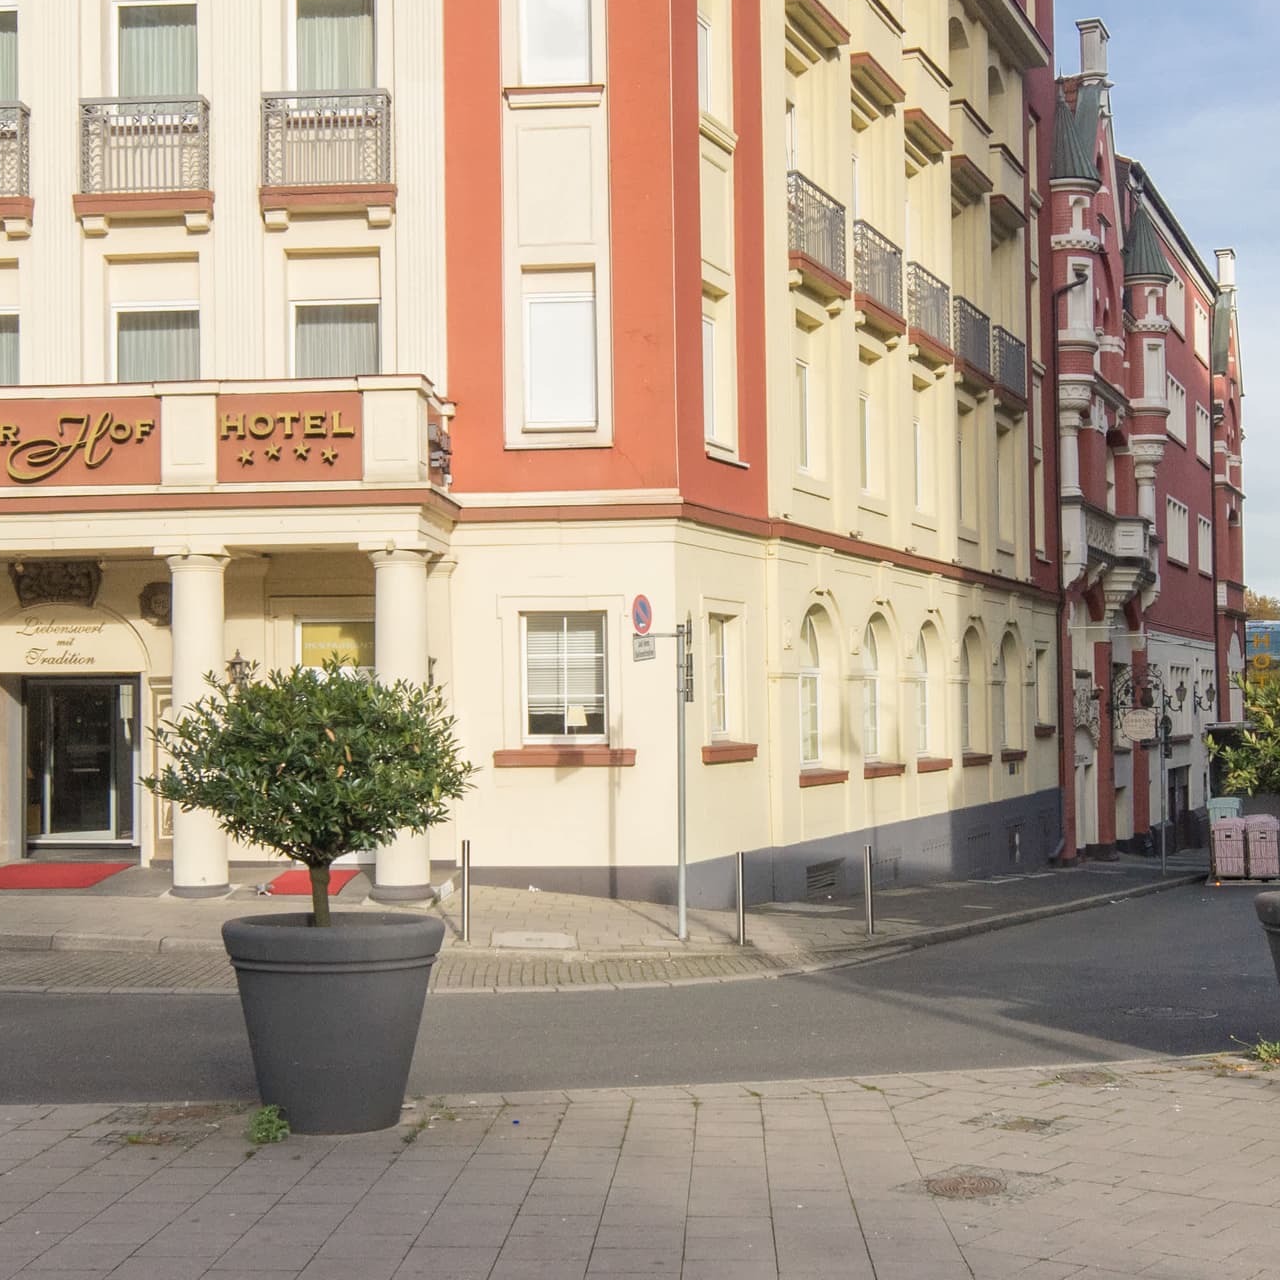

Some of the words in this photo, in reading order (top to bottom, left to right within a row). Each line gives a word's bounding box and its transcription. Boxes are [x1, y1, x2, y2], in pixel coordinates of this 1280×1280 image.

[220, 410, 355, 440] HOTEL
[16, 616, 105, 637] Liebenswert
[56, 637, 75, 647] mit
[25, 647, 96, 666] Tradition
